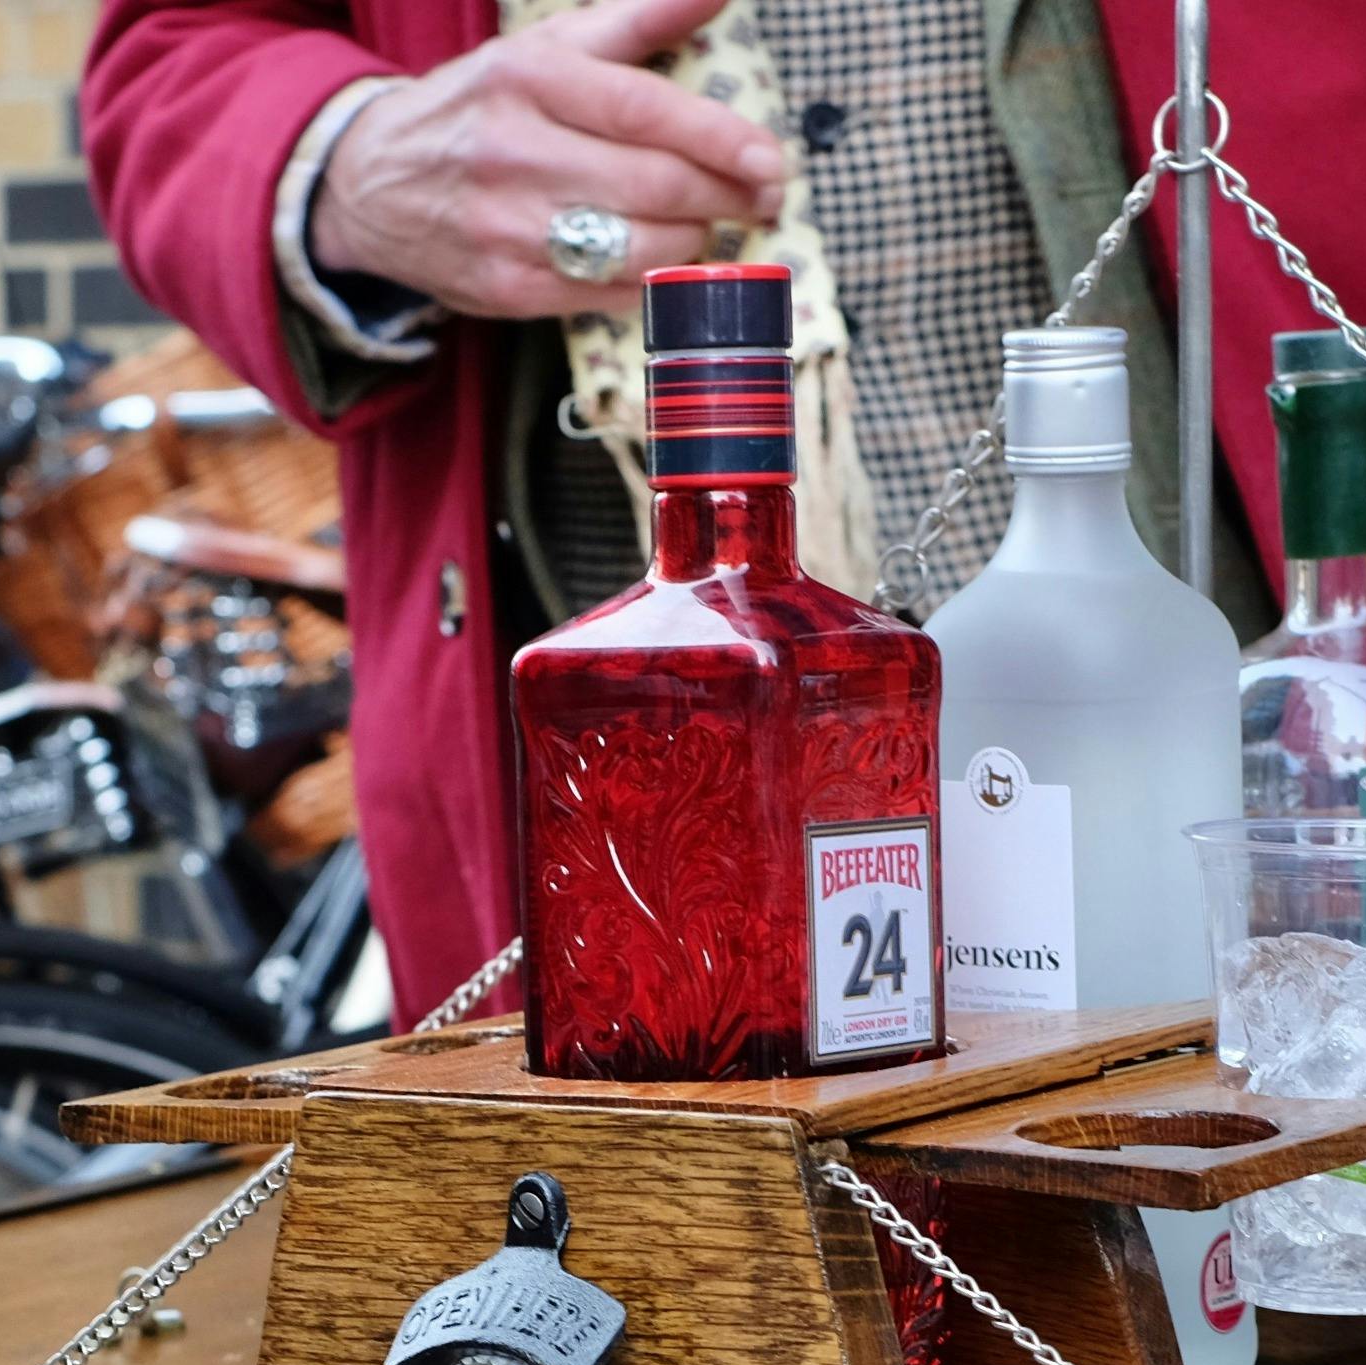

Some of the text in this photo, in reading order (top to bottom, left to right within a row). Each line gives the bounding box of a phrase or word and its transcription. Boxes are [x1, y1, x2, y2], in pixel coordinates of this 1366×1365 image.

[820, 843, 923, 900] BEEFEATER
[842, 909, 906, 1000] 24
[946, 935, 1061, 972] jensen's
[843, 1020, 875, 1032] LONDON
[401, 1286, 492, 1345] OPEN
